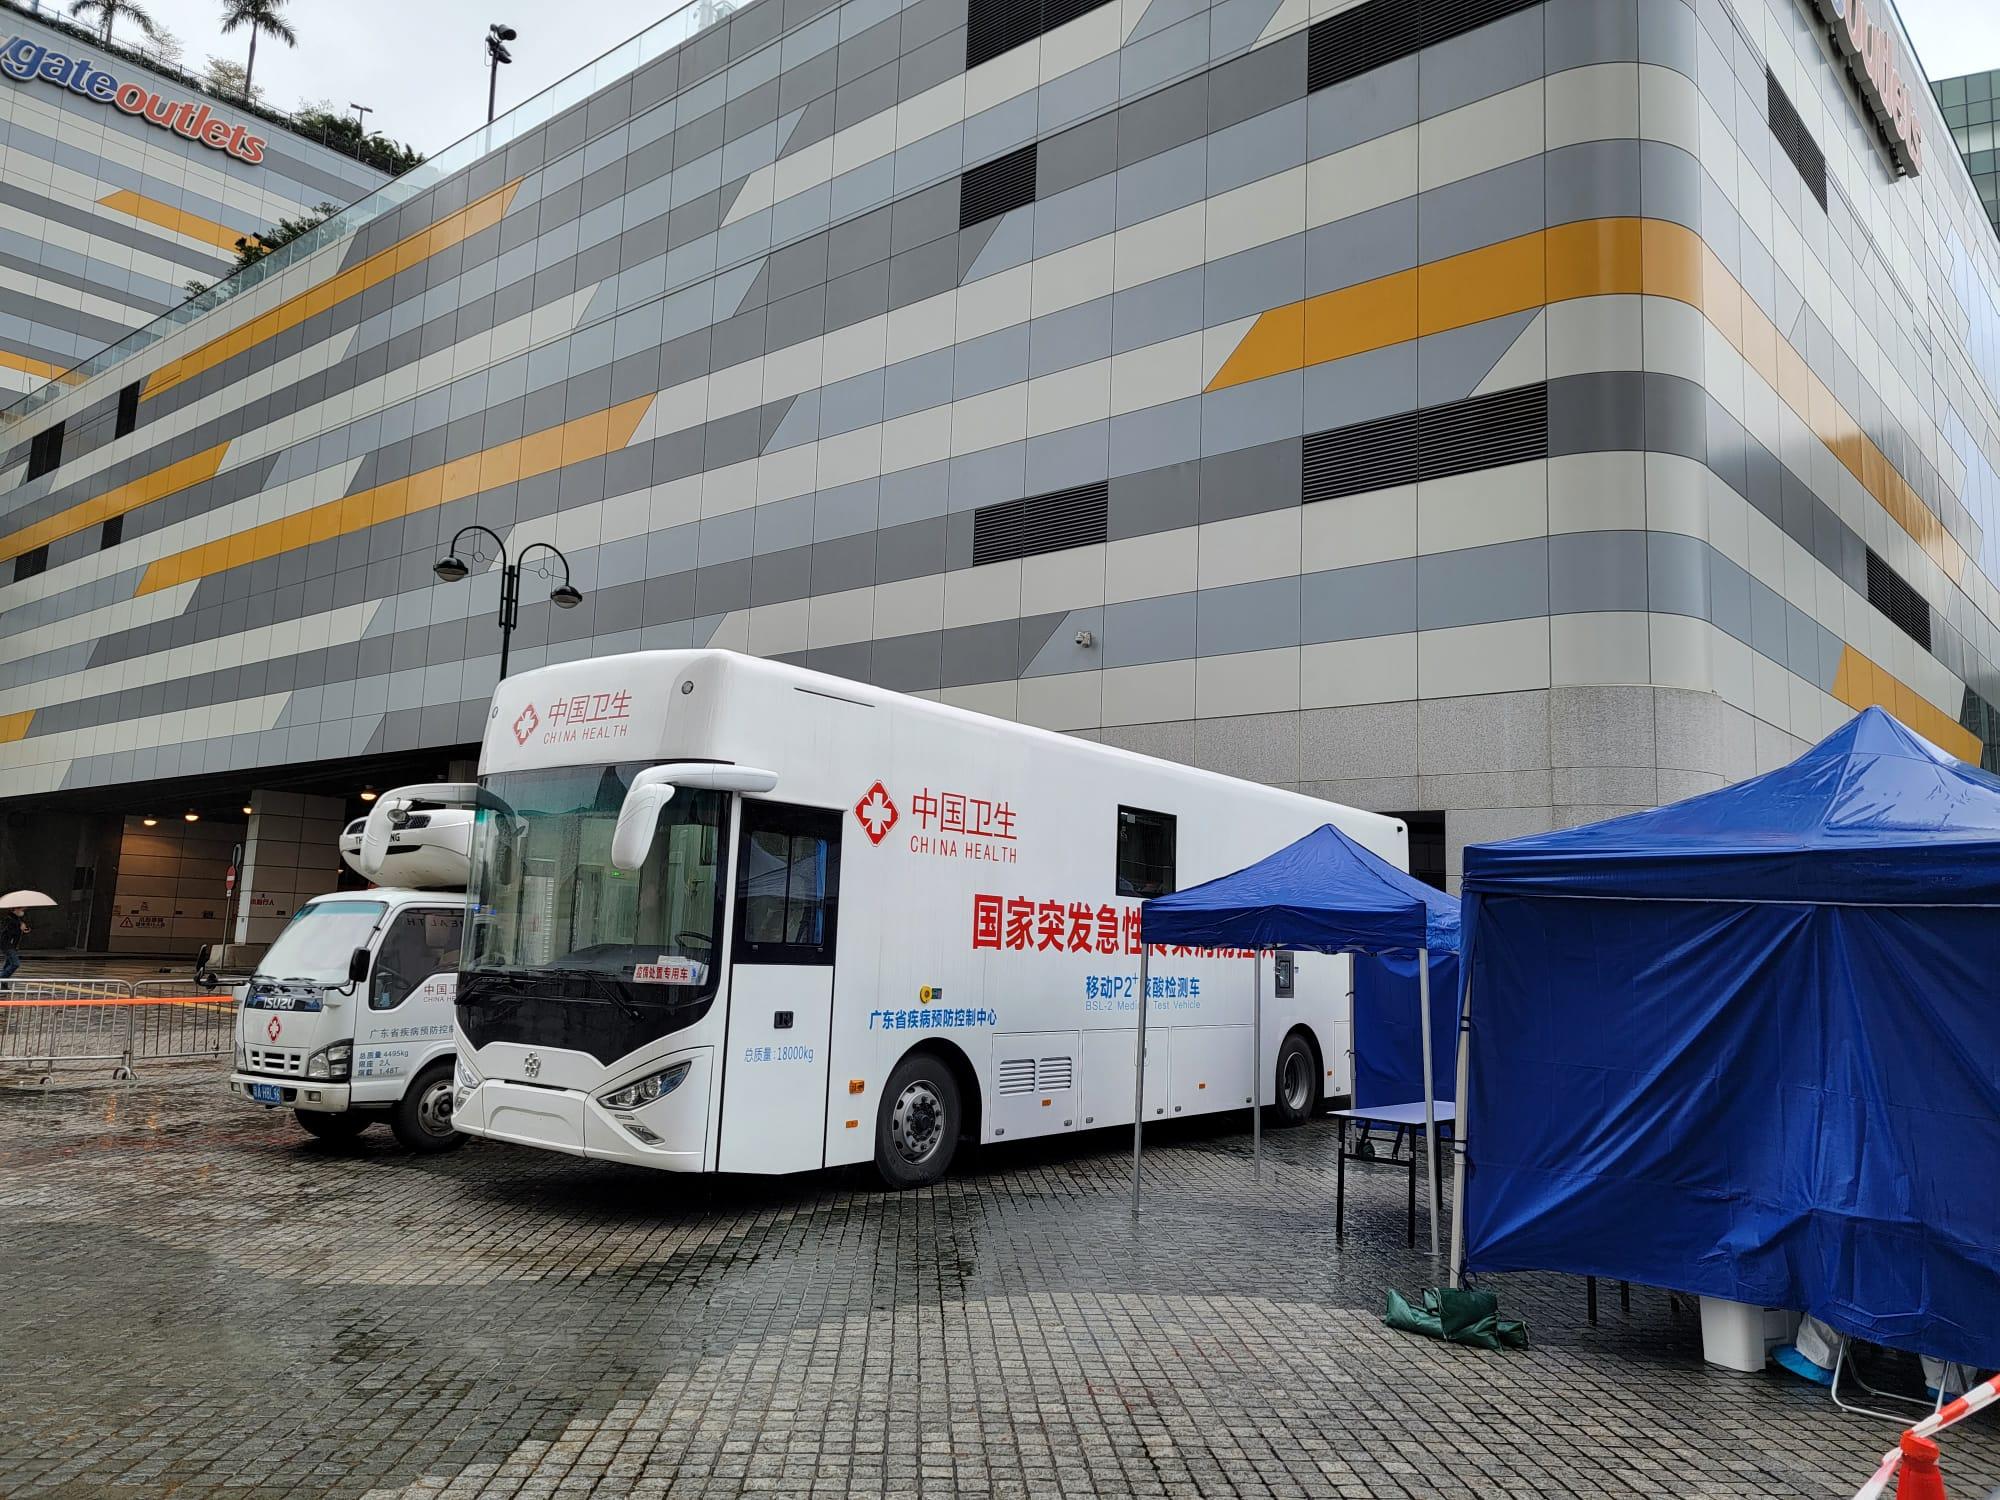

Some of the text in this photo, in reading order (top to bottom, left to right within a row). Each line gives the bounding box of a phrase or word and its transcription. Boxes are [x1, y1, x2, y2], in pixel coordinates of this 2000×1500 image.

[547, 689, 633, 727] 中国卫生
[543, 724, 628, 745] CHINA HEALTH
[912, 787, 1017, 840] 中国卫生
[910, 835, 1017, 864] CHINA HEALTH
[263, 997, 296, 1010] ISUZU
[1085, 1001, 1112, 1011] BSL-2
[1153, 1000, 1169, 1009] Test
[1173, 1000, 1200, 1009] Vehicle
[869, 1008, 997, 1030] 广东省疾病预防控制中心
